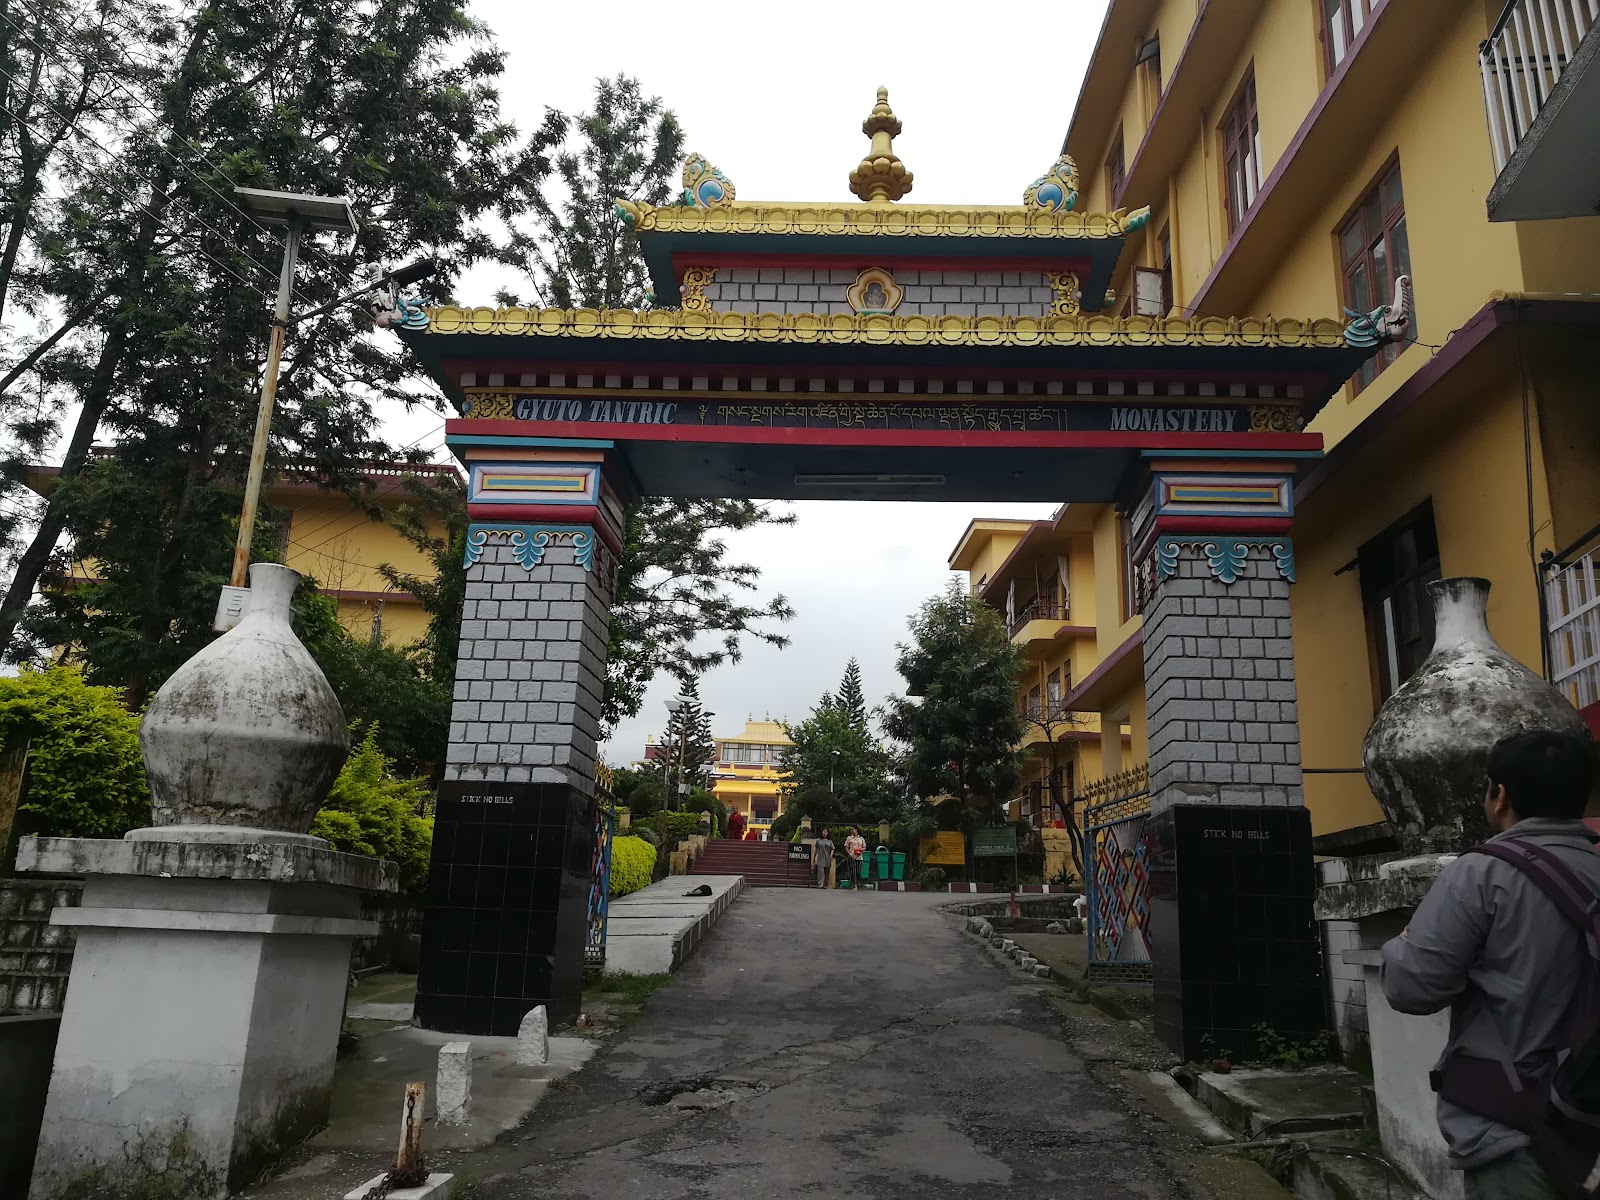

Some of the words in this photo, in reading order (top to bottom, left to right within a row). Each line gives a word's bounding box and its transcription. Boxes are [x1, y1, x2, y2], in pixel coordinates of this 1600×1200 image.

[516, 398, 583, 421] GYUTO
[589, 400, 678, 424] TANTRIC
[1110, 407, 1238, 432] MONASTERY
[460, 795, 481, 803] STICK
[483, 796, 493, 804] NO
[494, 796, 514, 804] BILLS
[1203, 829, 1227, 838] STICK
[1231, 830, 1243, 839] NO
[1248, 831, 1270, 840] BILLS
[788, 852, 810, 860] PARKING
